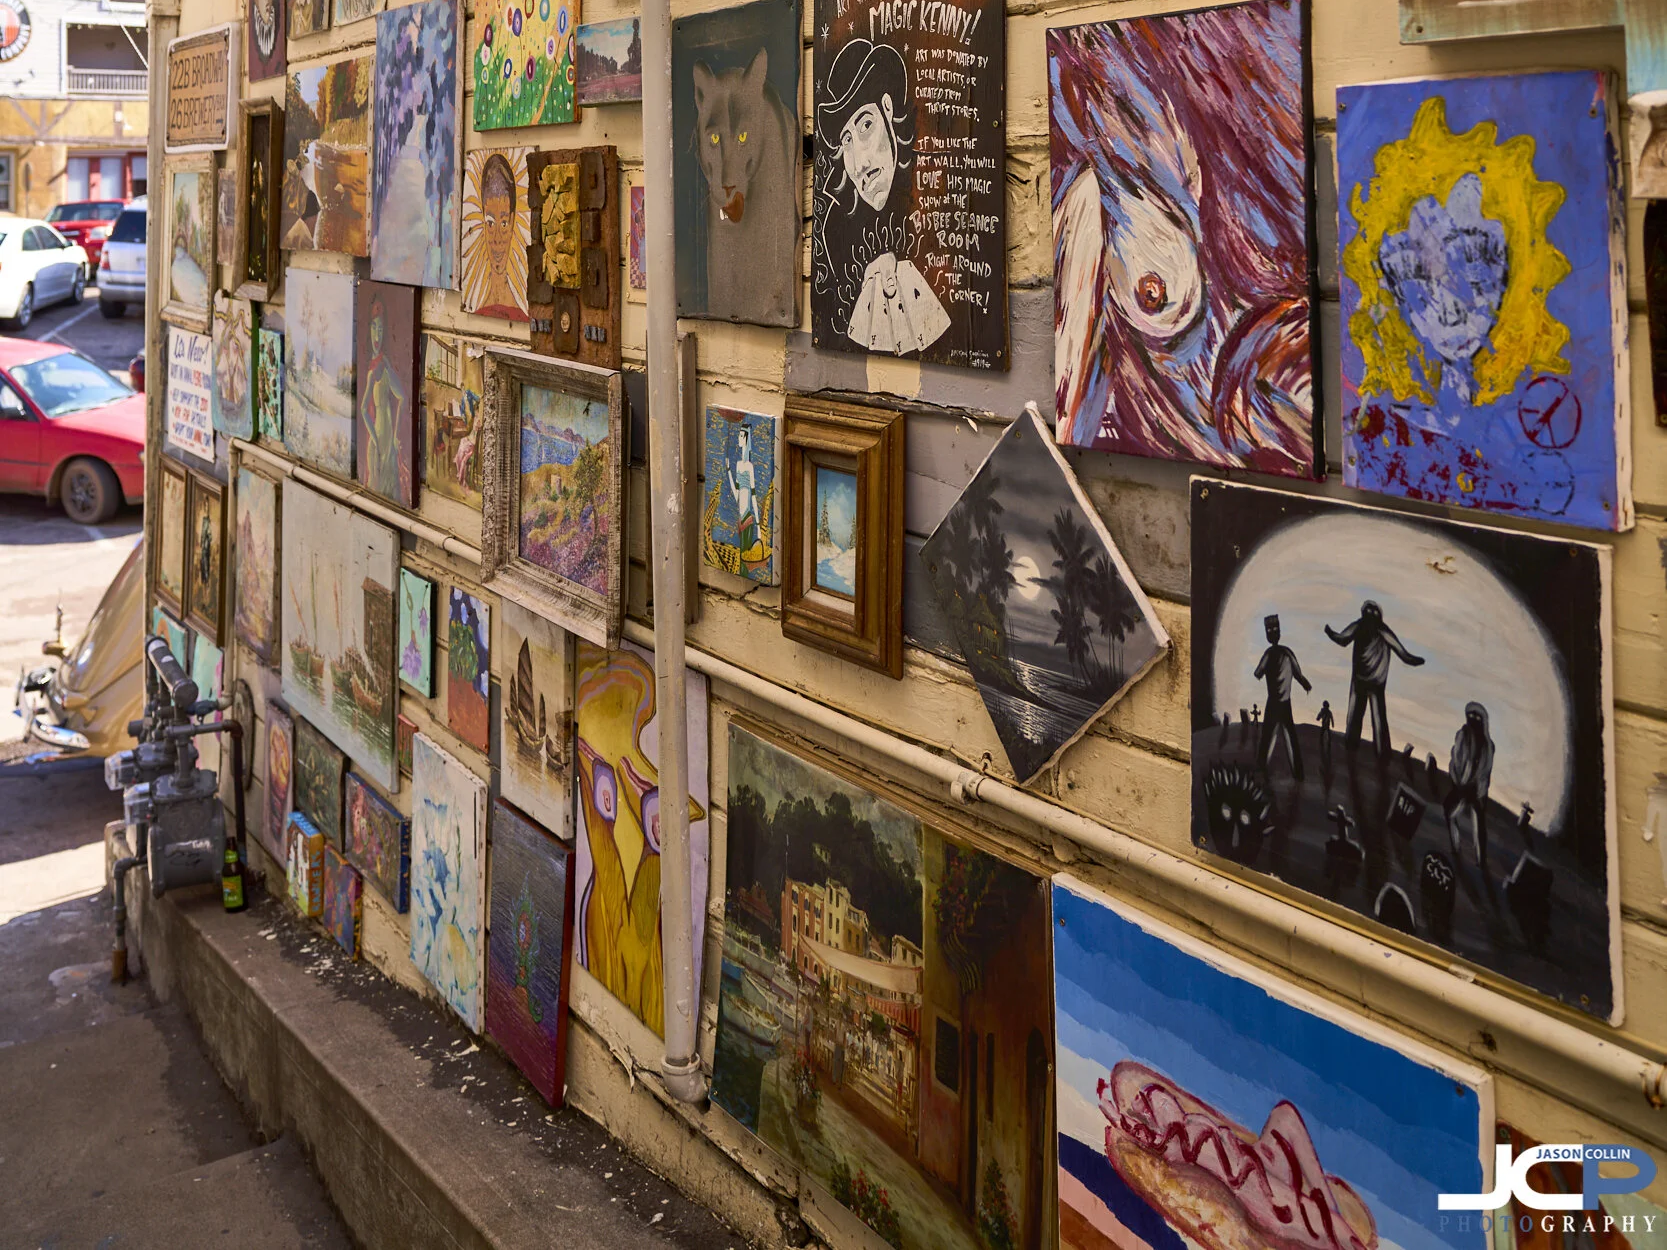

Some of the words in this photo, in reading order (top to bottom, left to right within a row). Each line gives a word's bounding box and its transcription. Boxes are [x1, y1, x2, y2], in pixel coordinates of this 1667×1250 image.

[869, 0, 917, 41] MAGIC
[919, 0, 982, 45] KENNY!
[915, 49, 928, 63] ART
[931, 48, 945, 59] WAS
[947, 49, 976, 67] DONATED
[977, 55, 988, 69] BY
[172, 57, 190, 90] 22B
[916, 68, 935, 81] LOCAL
[936, 68, 966, 89] ARTISTS,
[966, 77, 977, 87] OR
[915, 86, 943, 100] CURATED
[944, 88, 961, 101] FROM
[171, 98, 183, 130] 26
[925, 102, 950, 115] THRIFT
[951, 105, 980, 122] STORES.
[917, 135, 930, 150] IF
[930, 136, 944, 149] YOU
[946, 137, 961, 148] LIKE
[962, 136, 978, 150] THE
[916, 154, 931, 168] ART
[933, 155, 963, 170] WALL,
[963, 154, 976, 169] YOU
[977, 156, 996, 169] WILL
[916, 170, 943, 191] LOVE
[946, 173, 963, 191] HIS
[965, 177, 992, 194] MAGIC
[918, 195, 941, 210] SHOW
[951, 193, 968, 209] THE
[908, 210, 951, 234] BISBEE
[953, 210, 999, 234] SEANCE
[936, 230, 980, 251] ROOM
[925, 252, 950, 268] RIGHT
[952, 255, 992, 278] AROUND
[945, 273, 961, 286] THE
[949, 288, 990, 314] CORNER!
[1398, 796, 1415, 816] RIP
